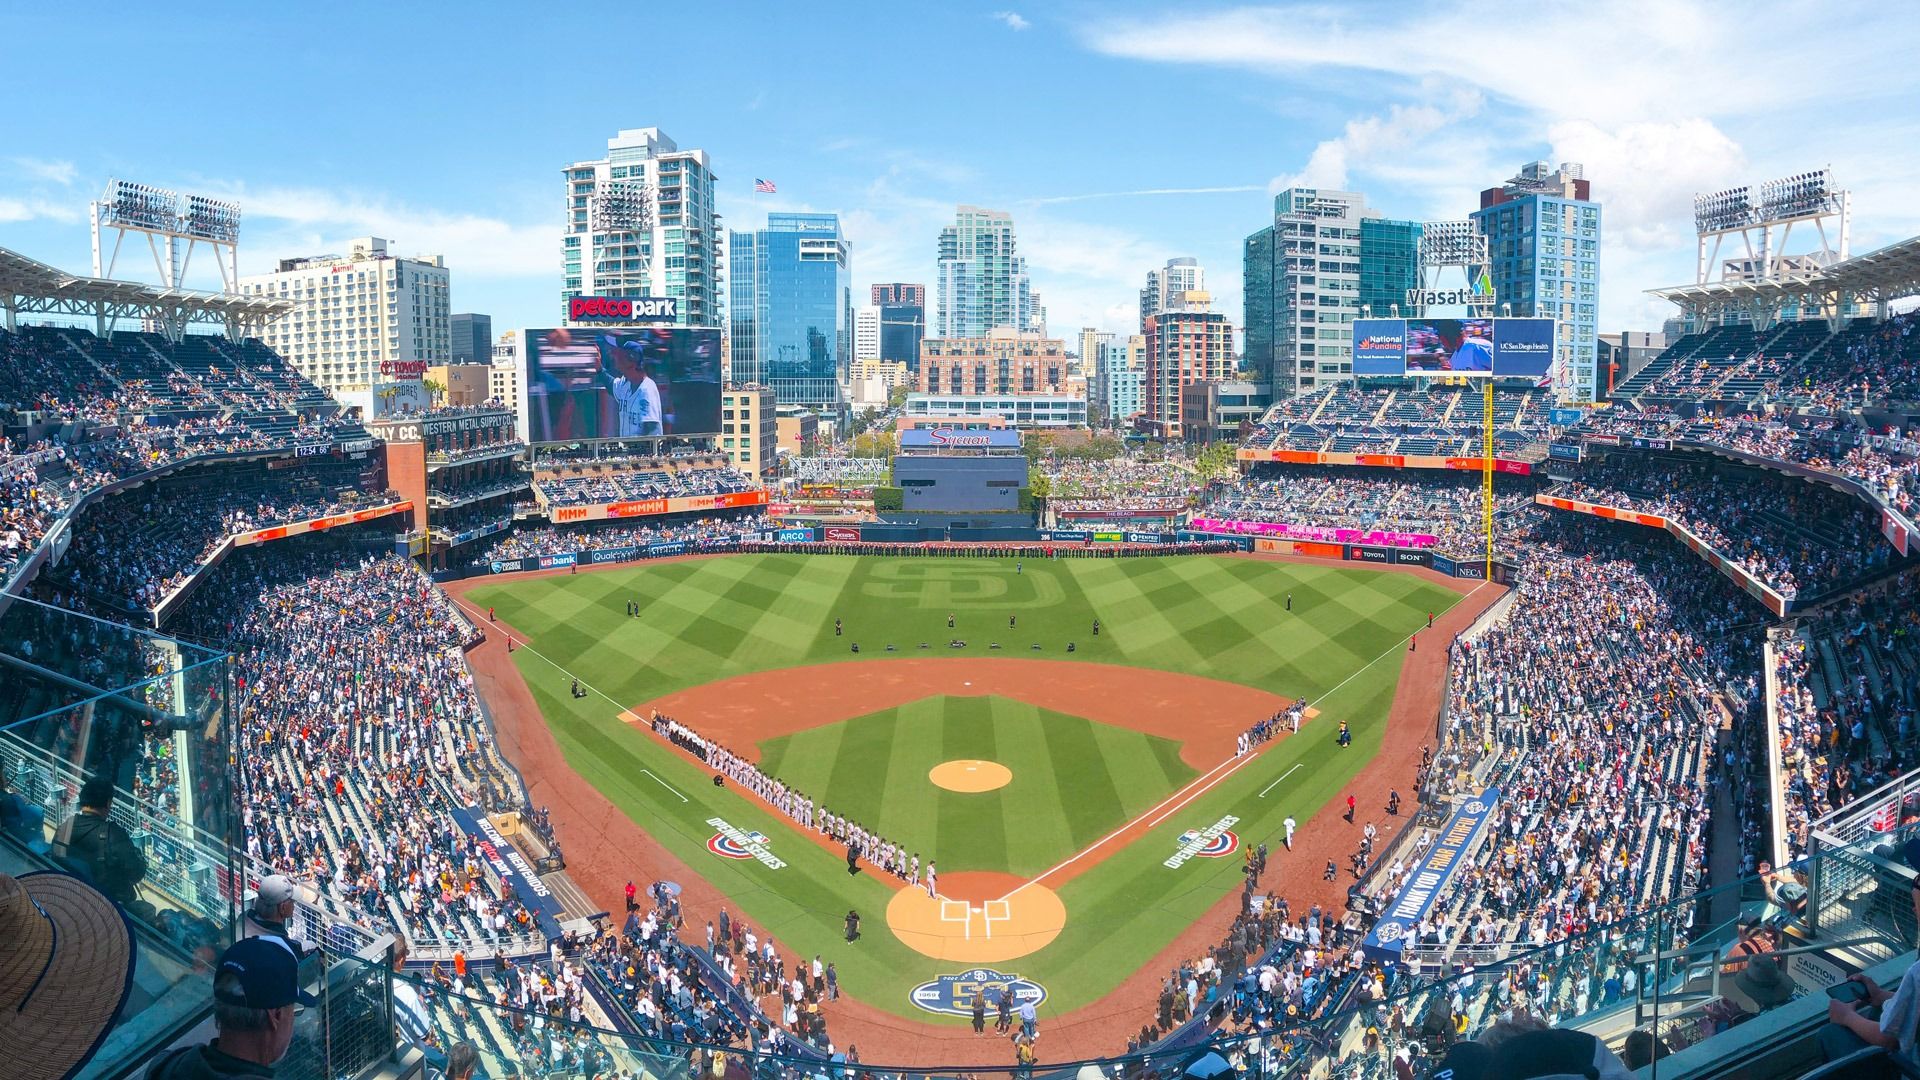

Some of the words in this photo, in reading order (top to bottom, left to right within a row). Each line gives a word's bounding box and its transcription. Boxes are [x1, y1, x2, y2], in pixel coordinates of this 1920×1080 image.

[1409, 289, 1467, 305] Viasat
[1370, 335, 1402, 343] National
[1370, 343, 1402, 351] Funding
[1500, 342, 1509, 350] UC
[1509, 342, 1519, 350] San
[1518, 342, 1533, 351] Diego
[395, 361, 427, 374] TOYOTA
[423, 421, 457, 436] WESTERN
[459, 416, 480, 431] METAL
[480, 414, 502, 428] SUPPLY
[929, 427, 991, 450] Sycuan
[299, 446, 316, 456] 12:54
[788, 457, 888, 471] NATIONAL
[780, 532, 804, 541] ARCO
[828, 529, 855, 539] Sycuan
[1262, 541, 1275, 551] RA
[1459, 568, 1482, 578] NECA
[476, 817, 509, 848] WELCOME
[1441, 816, 1480, 848] FAITHFUL
[705, 817, 753, 846] OPENING
[743, 843, 788, 870] SERIES
[1163, 836, 1212, 870] OPENING
[1202, 814, 1241, 840] SERIES
[1425, 847, 1458, 873] FRIAR
[506, 851, 551, 897] BIENVENIDOS
[1416, 871, 1442, 891] YOU
[1391, 888, 1432, 919] THANK
[1797, 956, 1836, 983] CAUTION
